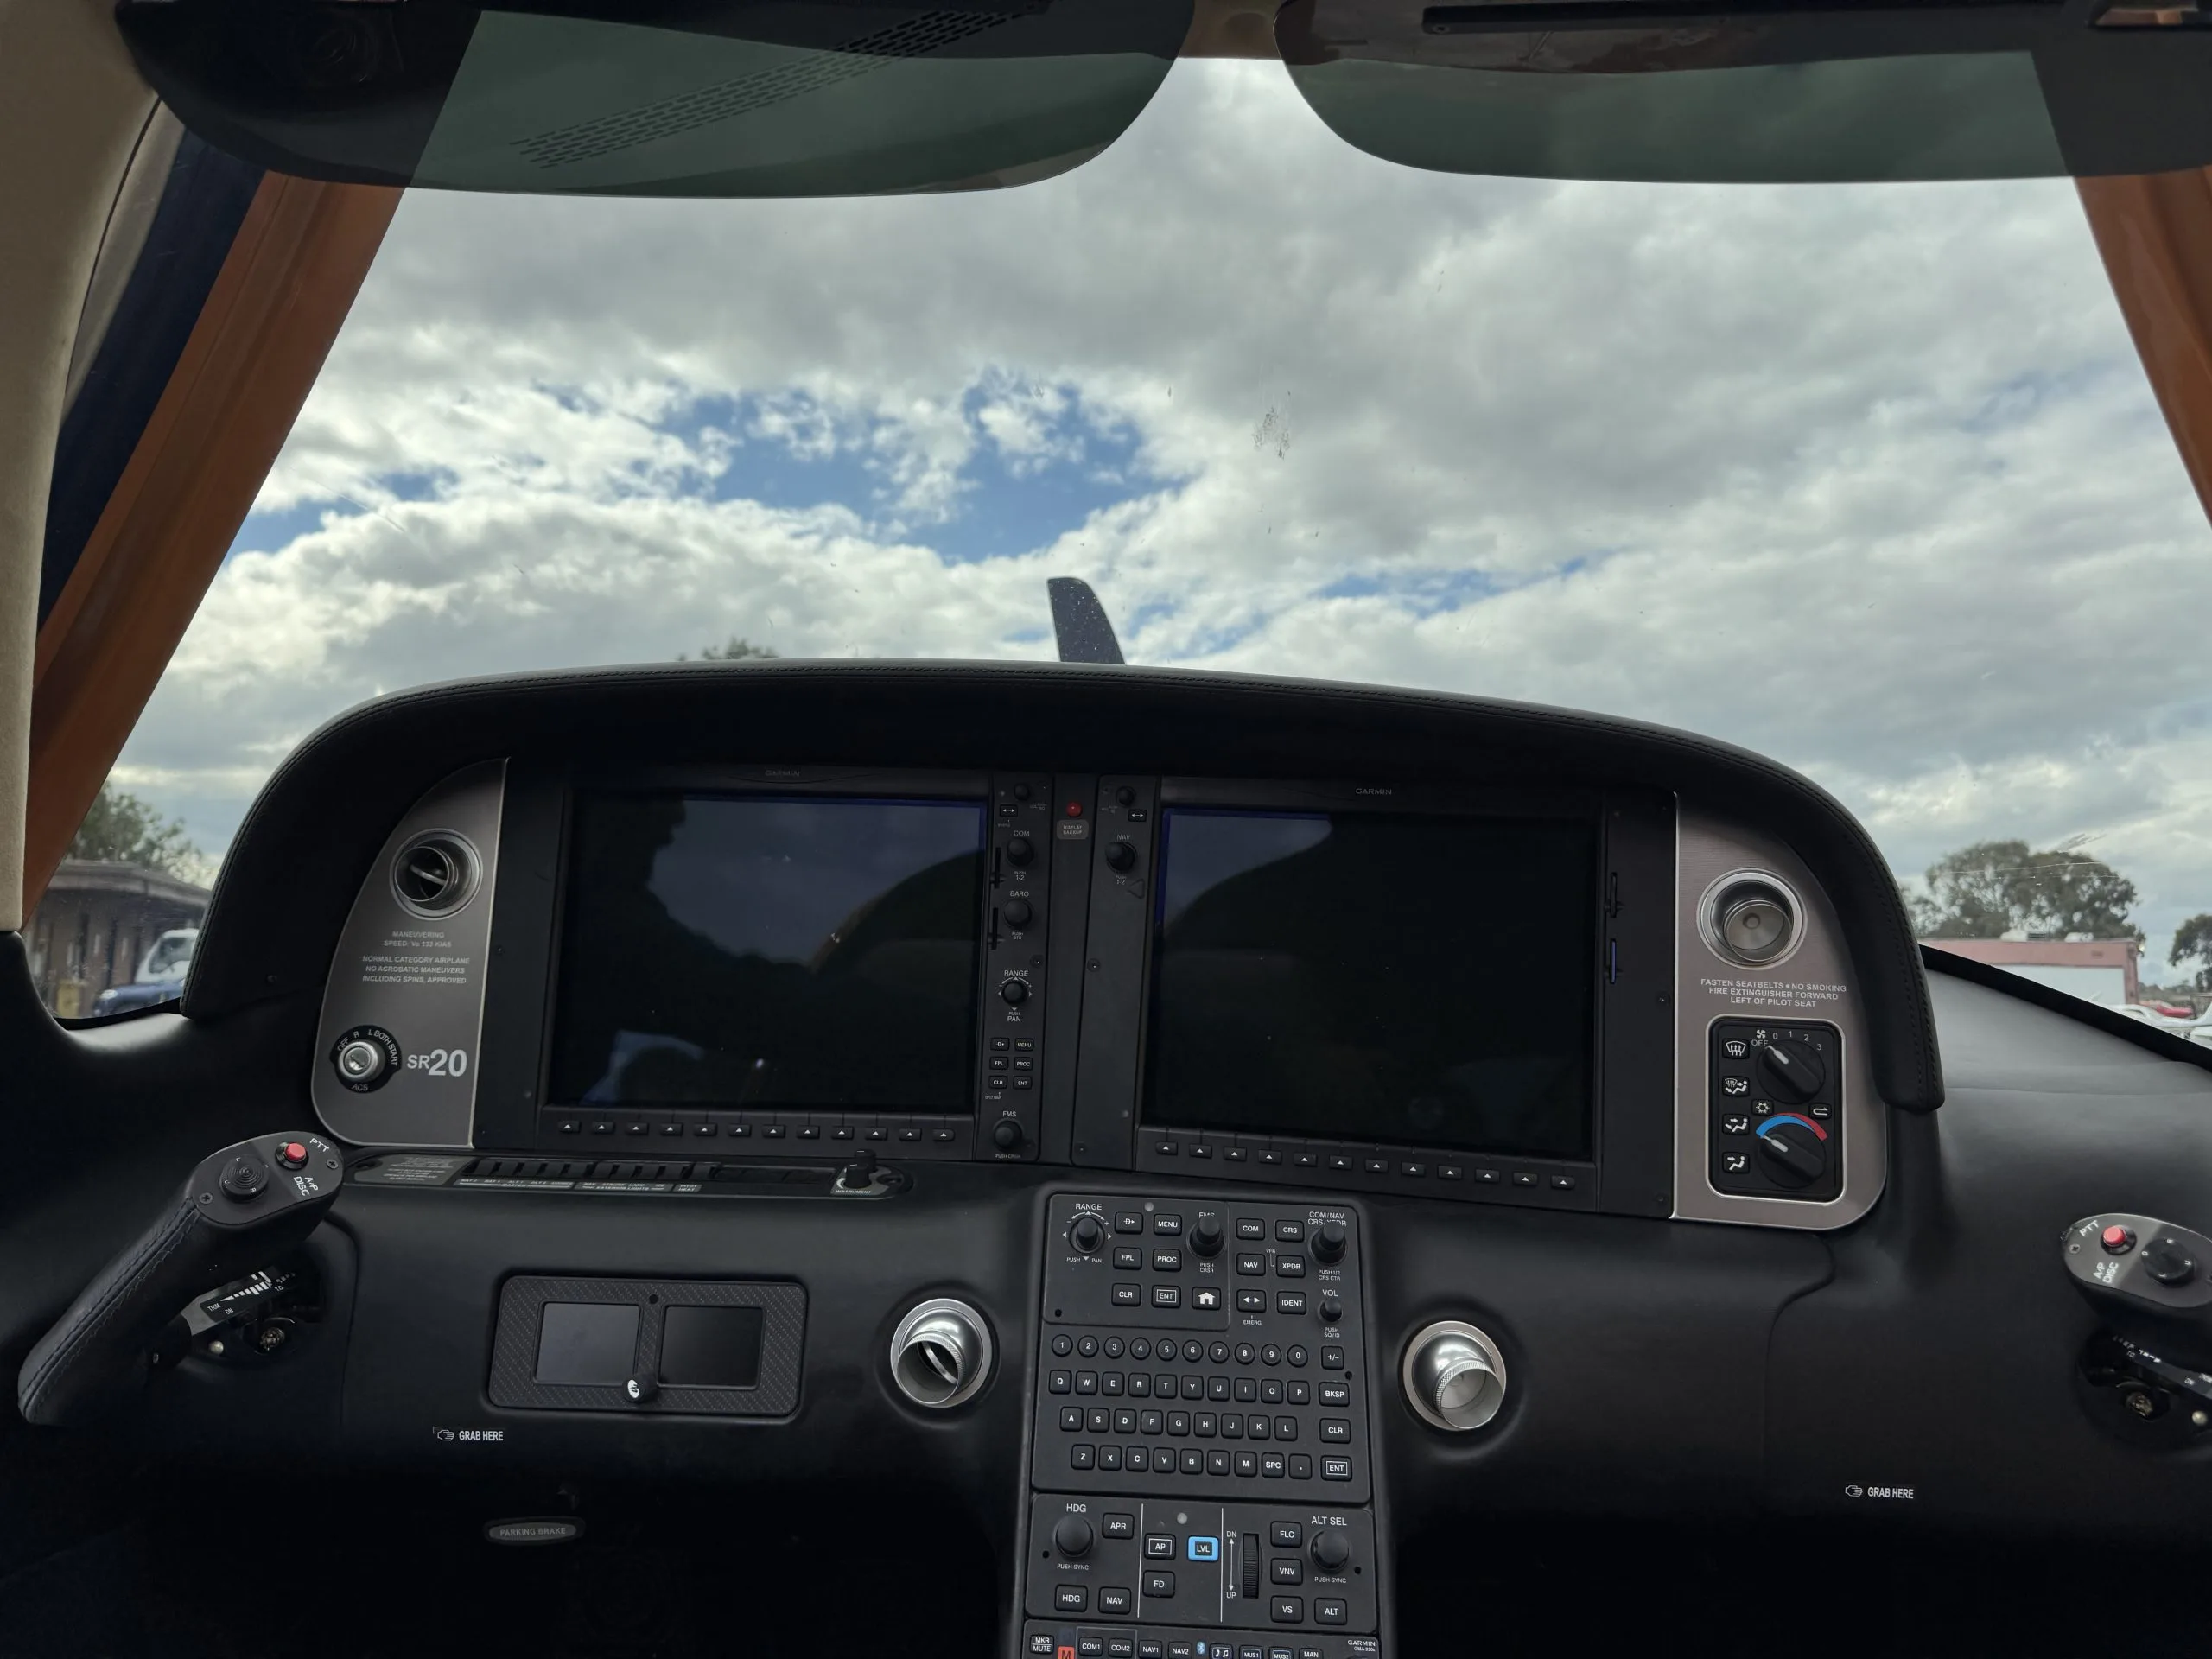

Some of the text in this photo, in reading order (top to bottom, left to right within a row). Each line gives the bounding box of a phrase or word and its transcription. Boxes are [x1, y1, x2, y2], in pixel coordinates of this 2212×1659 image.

[1735, 980, 1784, 988] SEATBELTS
[1806, 983, 1847, 993] SMOKING
[1730, 988, 1793, 998] EXTINGUISHER
[1795, 991, 1839, 1001] FORWARD
[337, 1037, 349, 1052] OFF
[374, 1029, 391, 1046] BOTH
[388, 1044, 397, 1065] START
[407, 1048, 467, 1077] SR20
[309, 1138, 330, 1153] PTT
[293, 1176, 309, 1196] DISC
[2080, 1219, 2100, 1236] PTT
[2102, 1262, 2119, 1284] DISC
[458, 1430, 504, 1441] GRAB HERE
[1867, 1487, 1914, 1499] GRAB HERE
[1311, 1516, 1347, 1526] ALT SEL
[499, 1527, 566, 1536] PARKING BRAKE
